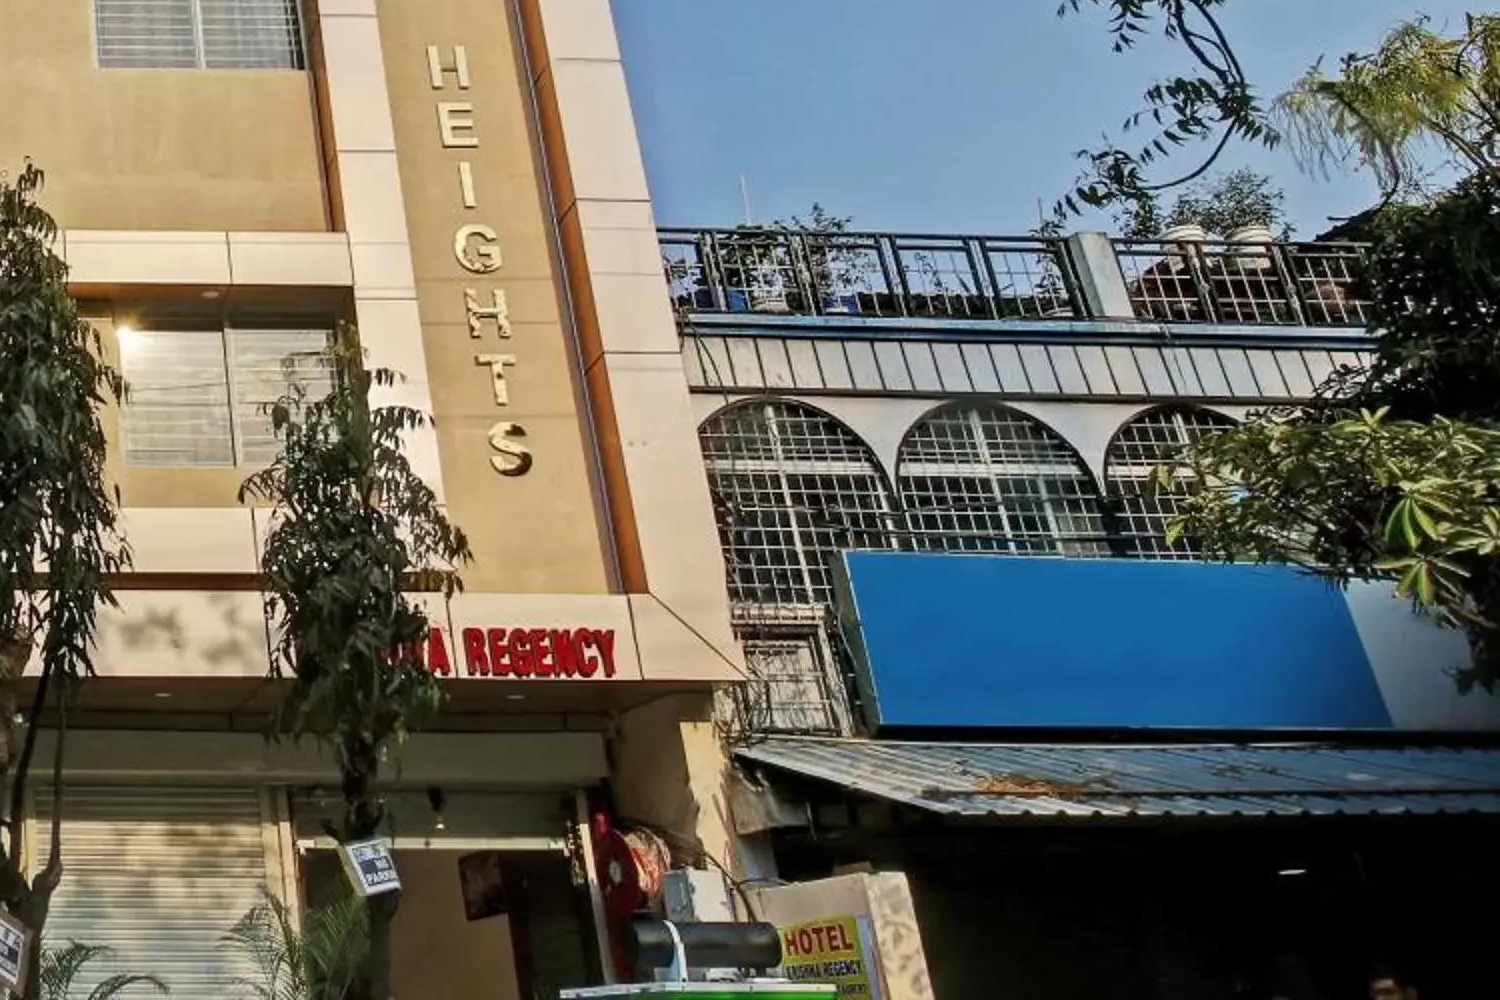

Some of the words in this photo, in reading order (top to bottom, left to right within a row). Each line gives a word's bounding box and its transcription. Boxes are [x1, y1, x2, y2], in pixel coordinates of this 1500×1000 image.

[425, 44, 533, 477] HEIGHTS
[462, 627, 615, 677] REGENCY
[785, 923, 853, 955] HOTEL
